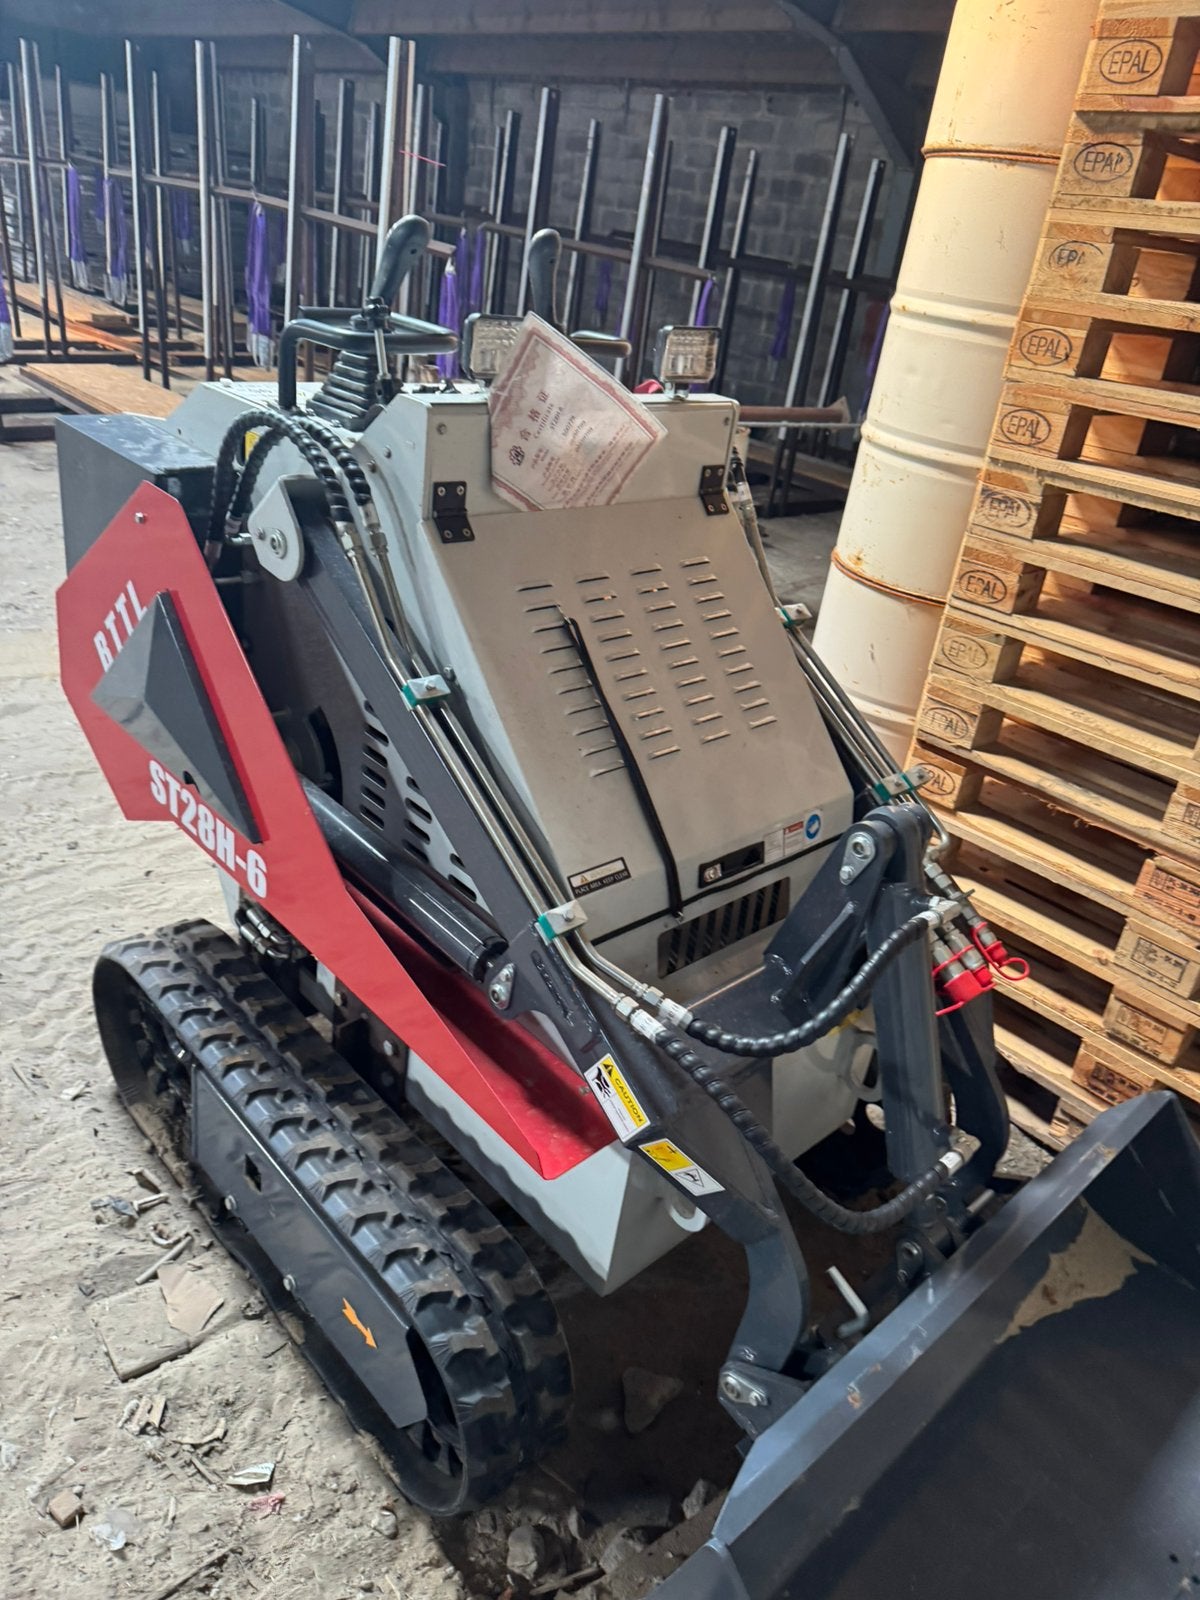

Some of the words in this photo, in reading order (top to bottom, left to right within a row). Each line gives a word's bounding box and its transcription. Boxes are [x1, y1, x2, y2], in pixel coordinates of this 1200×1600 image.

[1108, 50, 1150, 75] EPAL
[1027, 335, 1063, 360] EPAL
[533, 403, 554, 439] Certificate
[1007, 415, 1041, 440] EPAL
[966, 575, 999, 600] EPAL
[150, 759, 267, 899] ST28H-6
[614, 1078, 643, 1123] CAUTION
